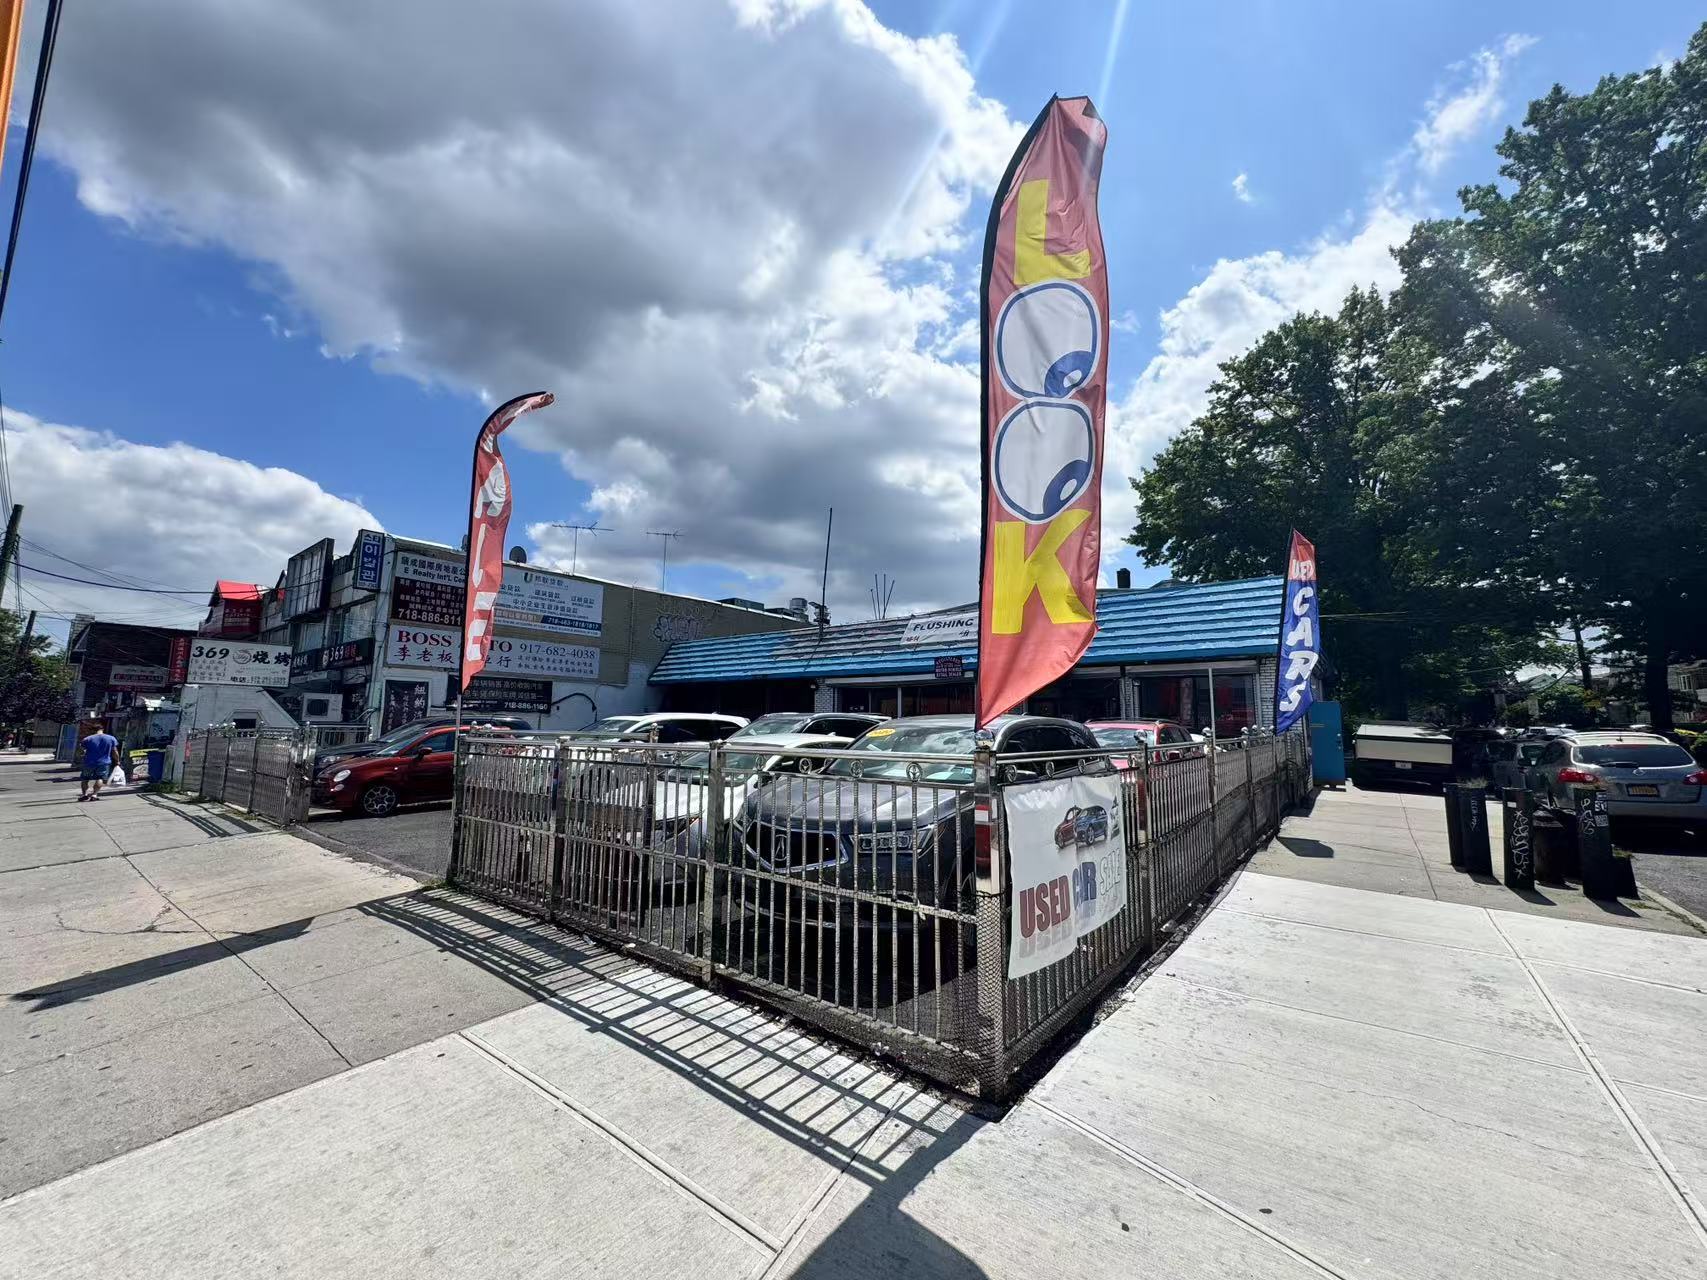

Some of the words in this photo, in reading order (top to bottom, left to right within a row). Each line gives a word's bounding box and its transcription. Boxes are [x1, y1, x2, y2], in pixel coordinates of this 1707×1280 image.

[991, 179, 1101, 634] LOOK
[412, 568, 435, 580] Realty
[913, 618, 974, 632] FLUSHING
[192, 646, 230, 660] 369
[394, 644, 454, 664] 李老板
[396, 630, 452, 647] BOSS
[520, 644, 596, 659] 917-682-4038
[1279, 586, 1318, 711] CARS
[252, 650, 292, 667] 烧烤
[1019, 875, 1070, 938] USED
